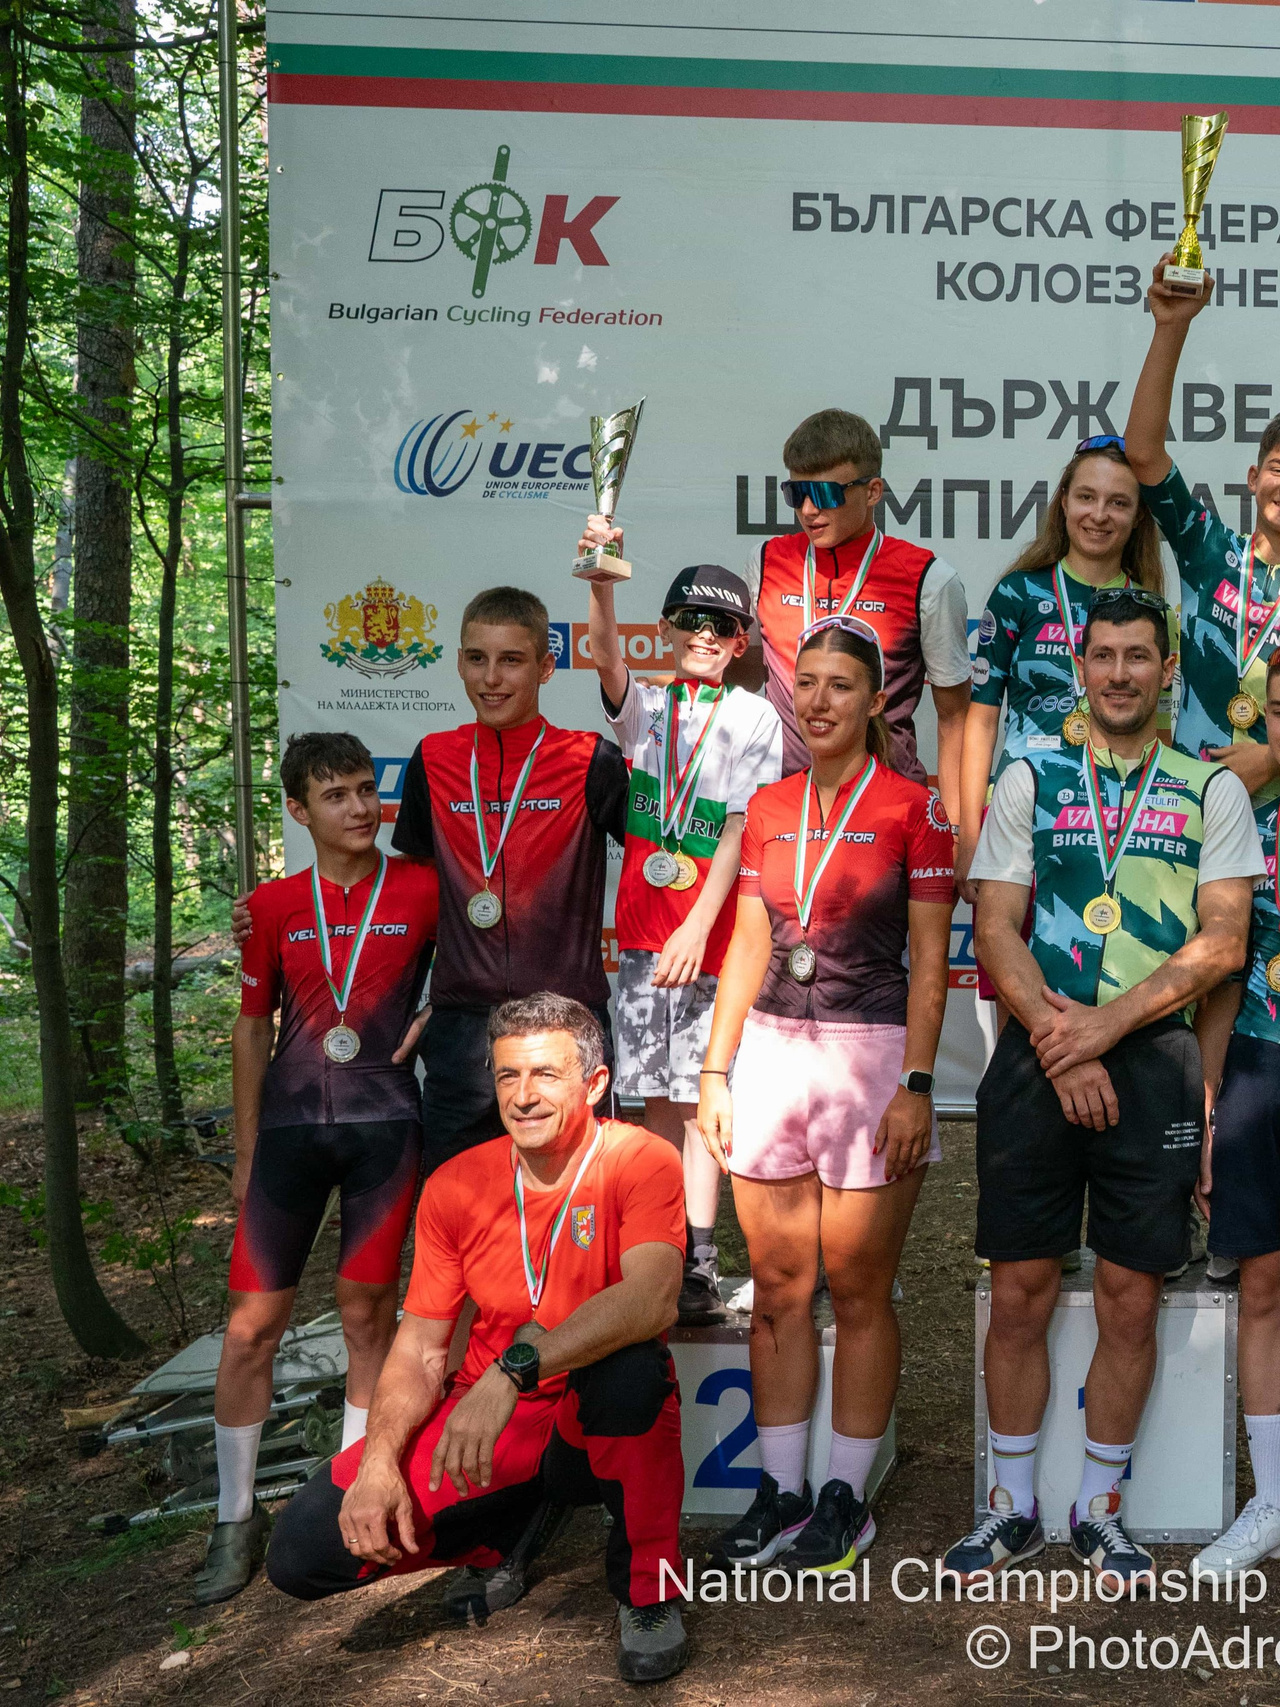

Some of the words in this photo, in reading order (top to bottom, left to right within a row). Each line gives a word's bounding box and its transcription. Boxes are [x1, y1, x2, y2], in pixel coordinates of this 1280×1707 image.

[791, 192, 1092, 240] БЪЛГАРСКА
[936, 261, 1279, 310] КОЛОЕЗНЕ
[328, 303, 438, 323] Bulgarian
[446, 305, 531, 327] Cycling
[538, 307, 663, 326] Federation
[488, 443, 594, 479] UEC
[482, 490, 496, 498] DE
[499, 491, 549, 499] CYCLISME
[485, 481, 519, 490] UNION
[521, 481, 590, 491] EUROPÉENNE
[682, 585, 743, 608] CANYON
[781, 594, 886, 613] VELRTOR
[340, 688, 430, 699] МИНИСТЕРСТВО
[317, 701, 334, 710] НА
[336, 701, 400, 712] МЛАДЕЖТА
[401, 702, 409, 711] И
[411, 702, 456, 712] СПОРТА
[1155, 777, 1187, 785] DIEM
[449, 798, 562, 814] VELRPTOR
[1067, 809, 1176, 834] VIOSHA
[1052, 833, 1098, 848] BIKE
[909, 868, 955, 879] MAXX
[693, 1368, 762, 1489] 2
